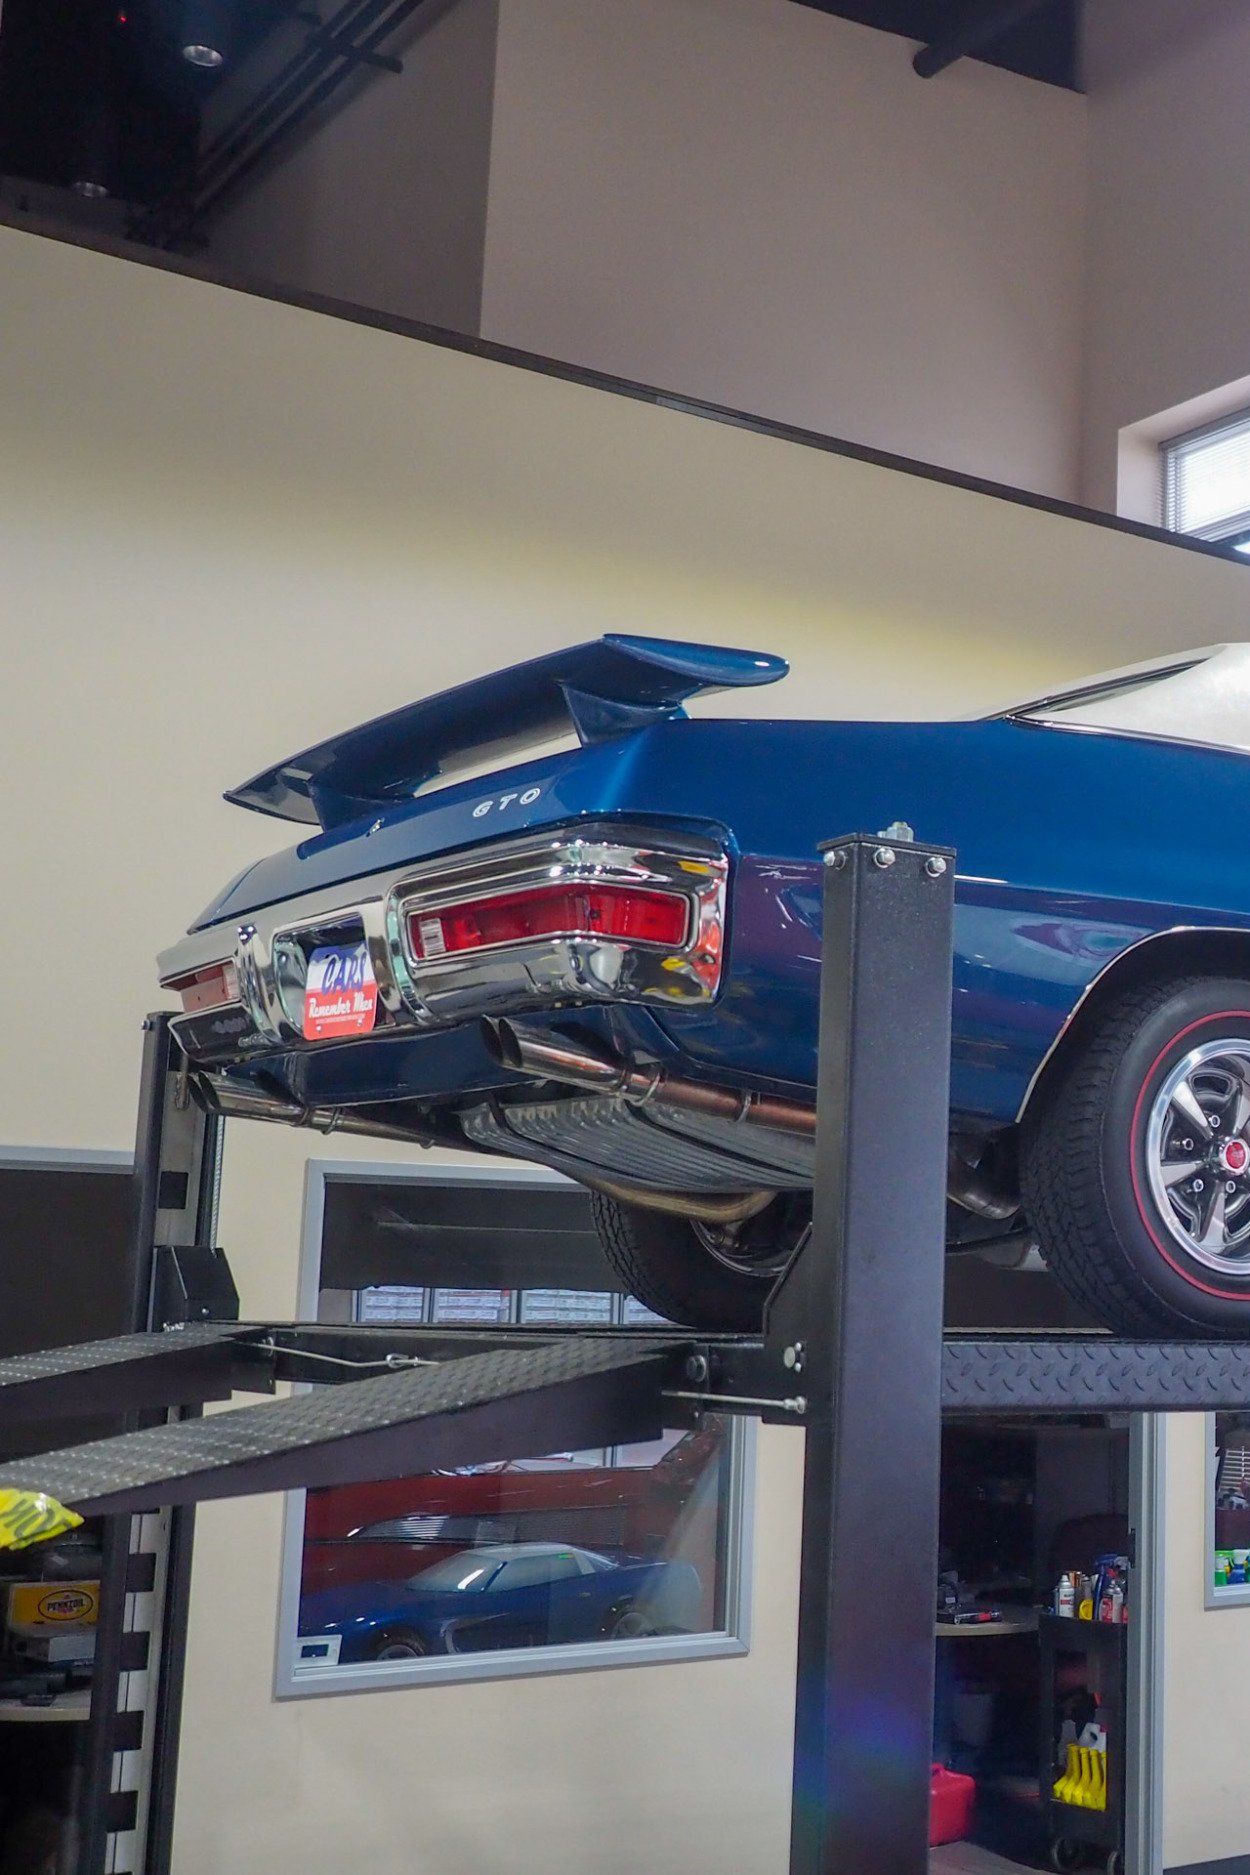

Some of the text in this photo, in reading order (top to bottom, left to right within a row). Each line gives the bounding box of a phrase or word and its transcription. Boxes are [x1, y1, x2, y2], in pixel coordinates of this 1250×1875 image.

[472, 788, 541, 818] GTO
[321, 950, 367, 995] CARS
[308, 997, 351, 1017] Remember
